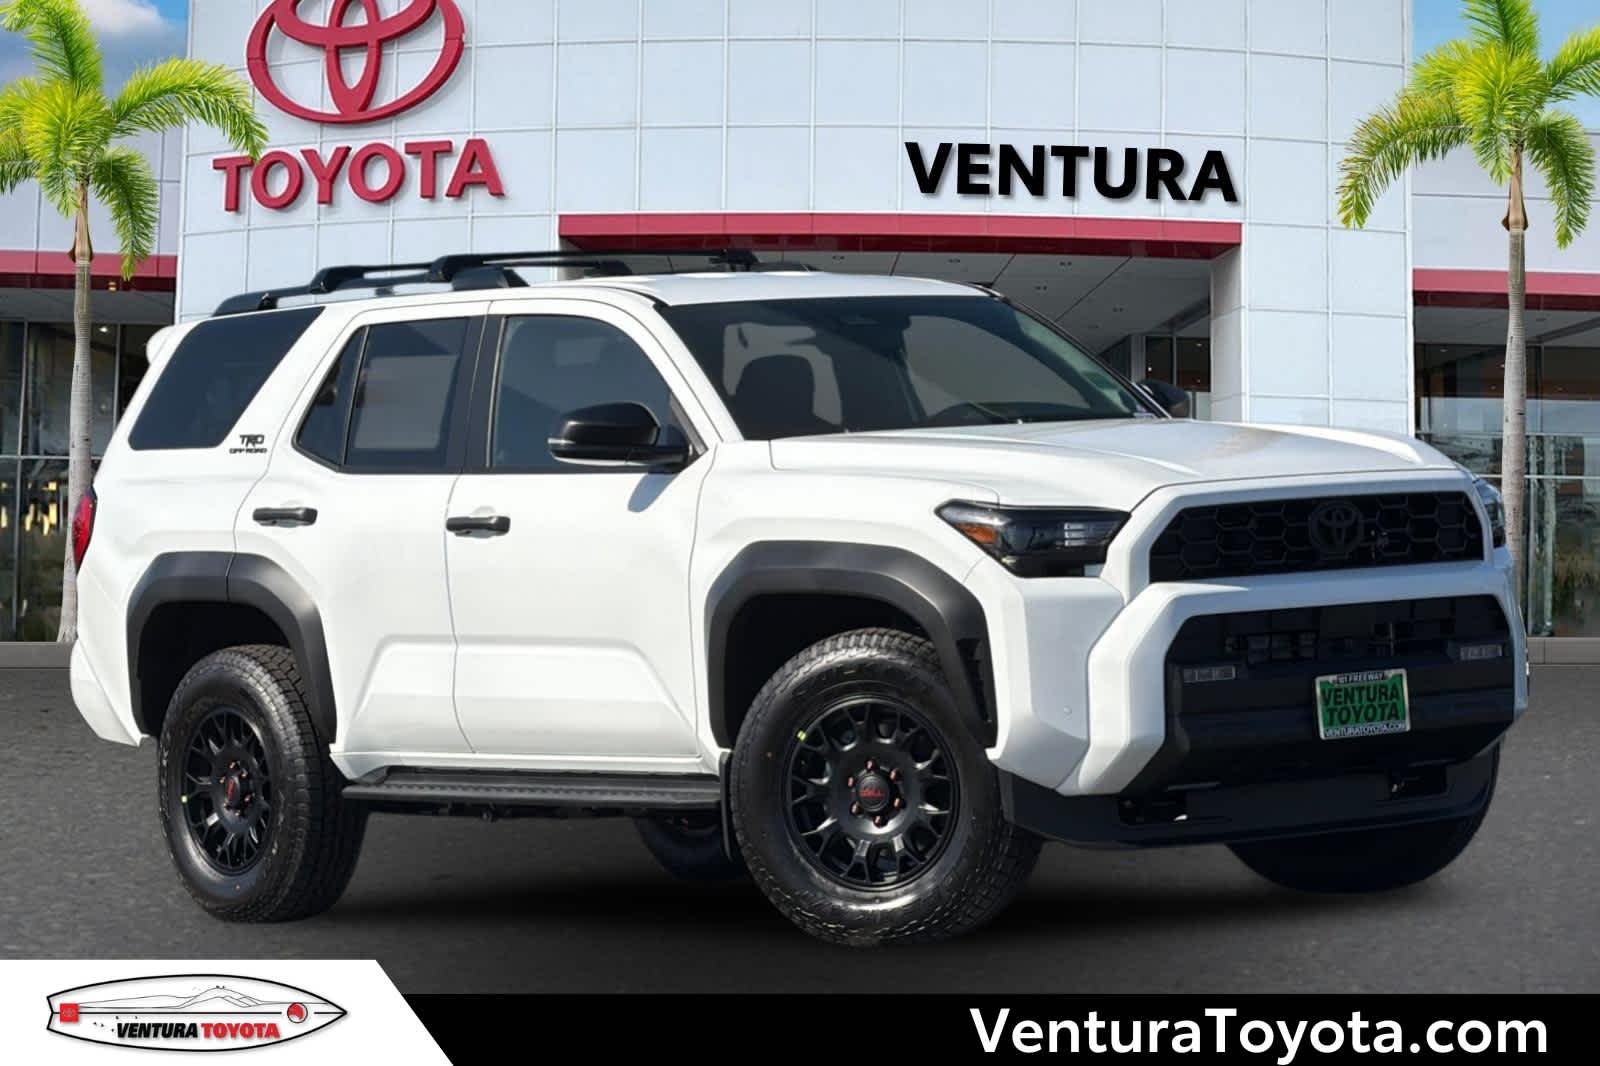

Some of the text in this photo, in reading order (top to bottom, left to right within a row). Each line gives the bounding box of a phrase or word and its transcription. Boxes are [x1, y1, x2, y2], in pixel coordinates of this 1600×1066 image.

[212, 138, 505, 213] TOYOTA
[904, 141, 1238, 203] VENTURA
[239, 434, 265, 447] TRD
[1320, 683, 1400, 706] VENTURA
[1327, 701, 1400, 726] TOYOTA
